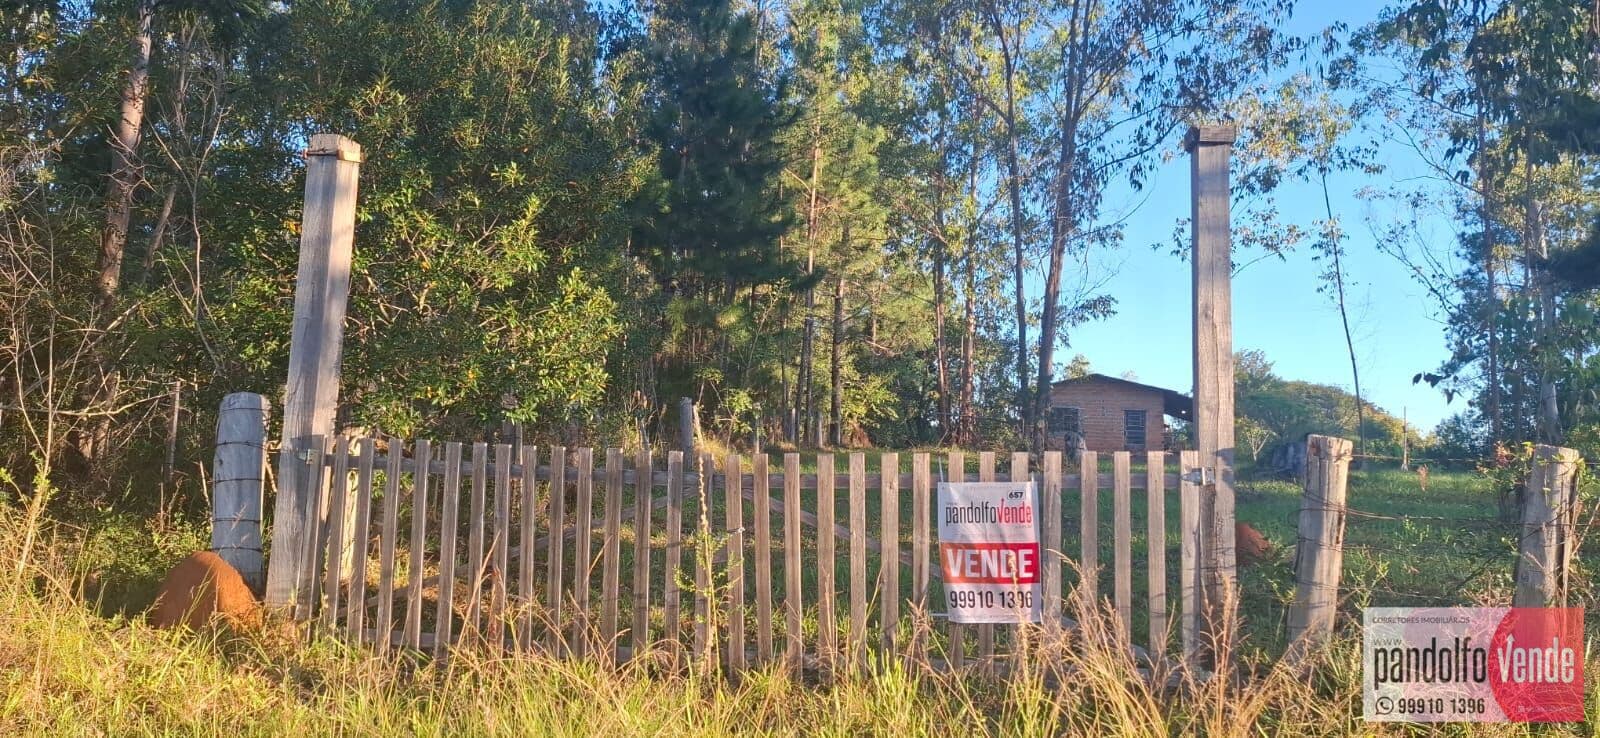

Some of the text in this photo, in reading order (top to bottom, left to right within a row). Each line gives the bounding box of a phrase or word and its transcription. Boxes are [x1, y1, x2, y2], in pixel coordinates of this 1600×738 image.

[1008, 491, 1024, 499] 657
[946, 549, 1033, 577] VENDE
[950, 590, 1033, 608] 99910 1396
